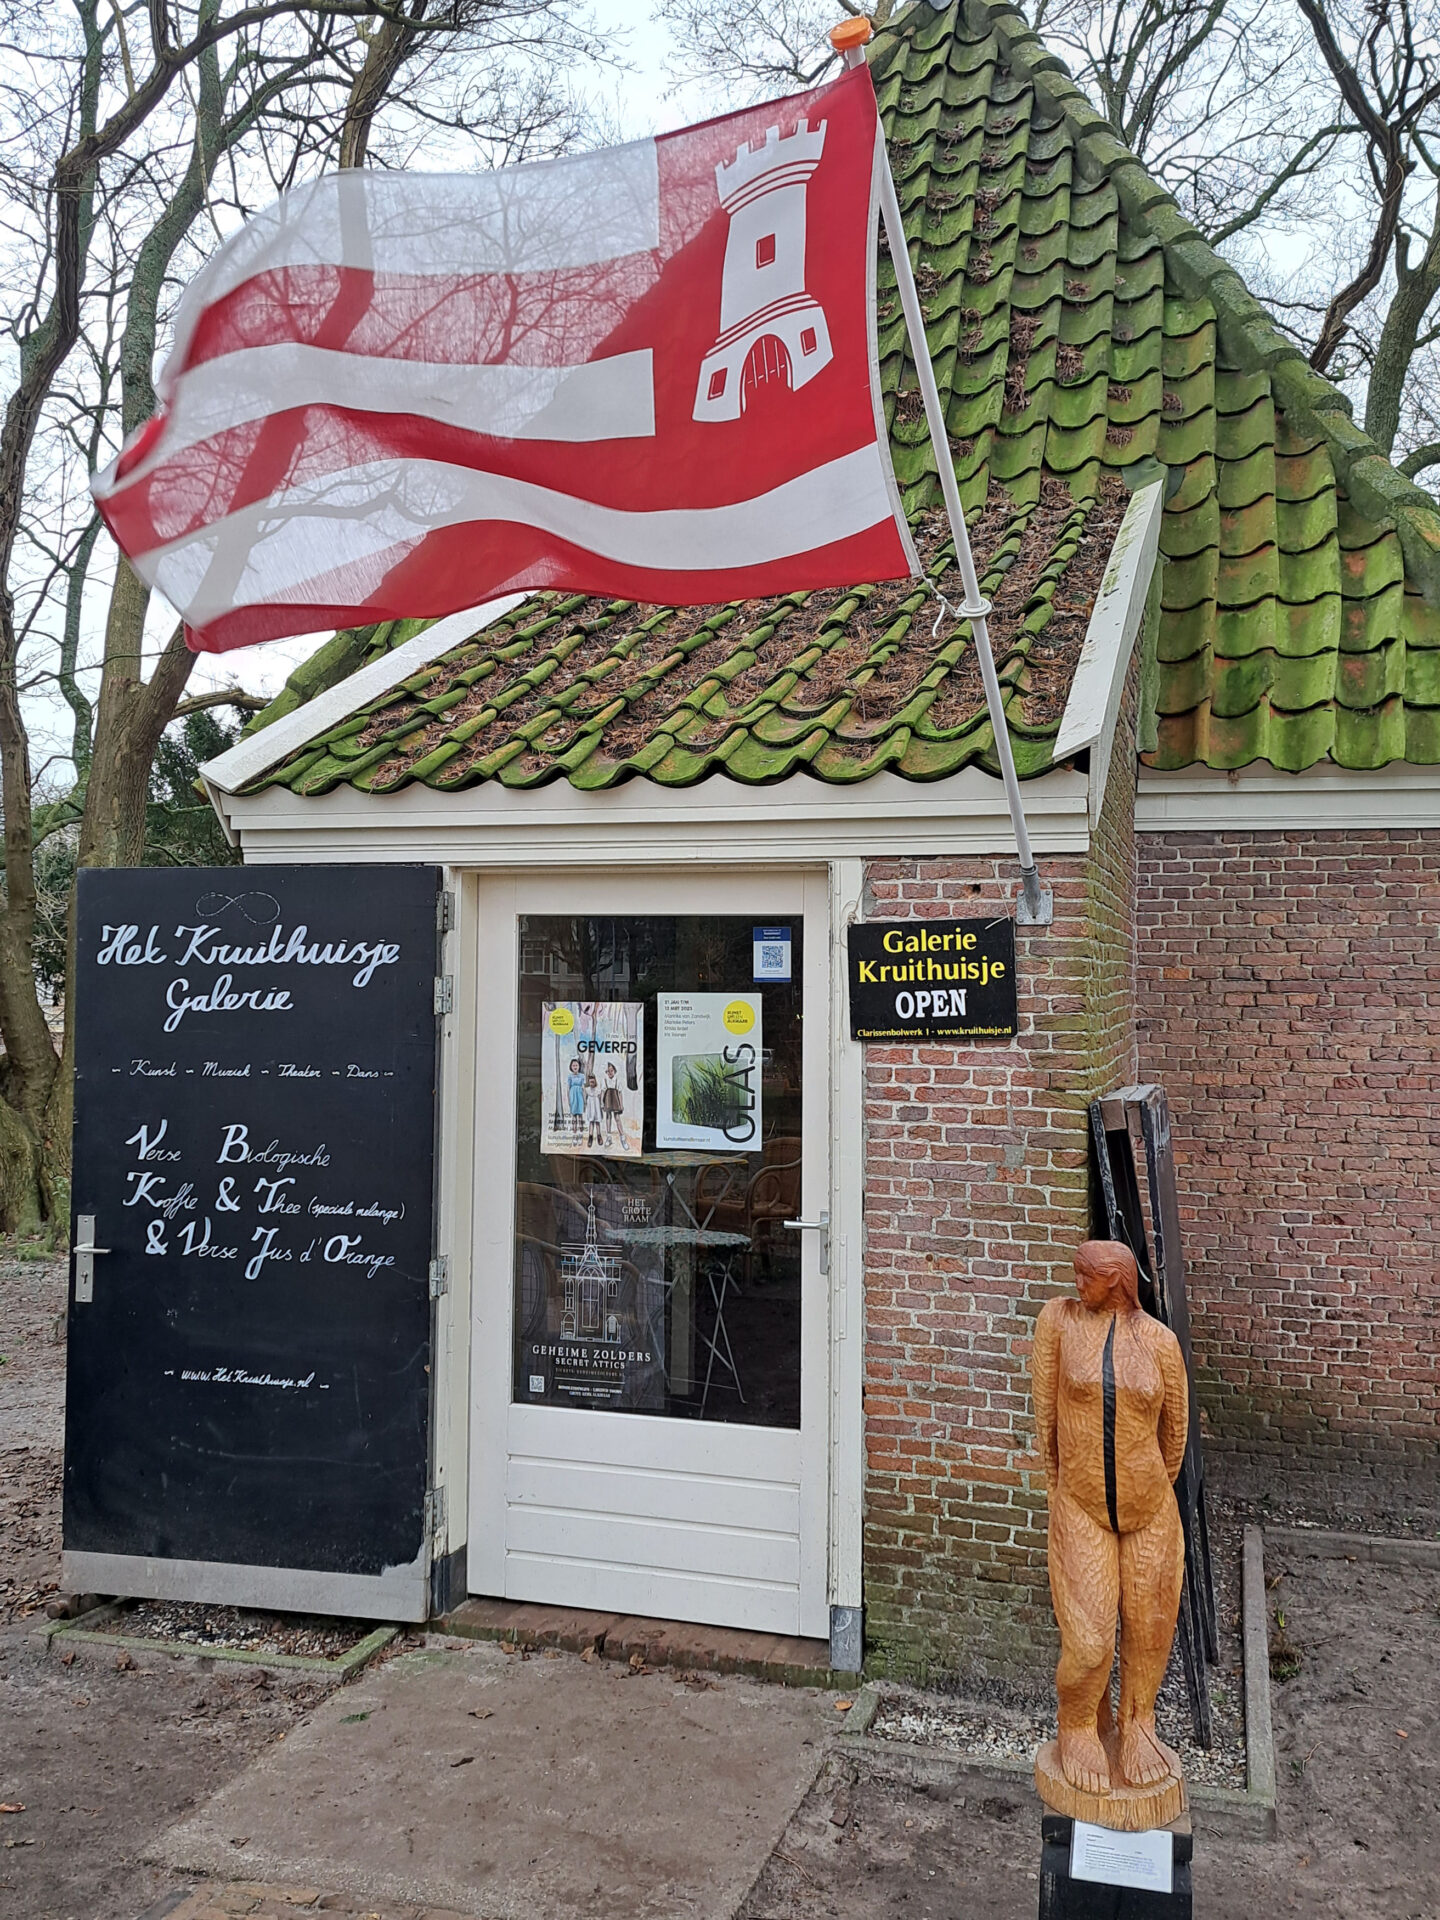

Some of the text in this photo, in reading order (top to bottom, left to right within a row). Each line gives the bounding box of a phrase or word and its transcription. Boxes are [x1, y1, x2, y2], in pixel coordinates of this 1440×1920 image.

[883, 927, 977, 953] Galerie
[97, 924, 401, 988] Het Kruithuisje
[858, 955, 1006, 986] Kruithuisje
[163, 973, 294, 1033] Galerie
[895, 988, 967, 1020] OPEN
[857, 1027, 923, 1037] Clarissenbolwerk
[937, 1026, 1012, 1037] www.kruithuisje.nl
[577, 1040, 637, 1054] GEVERFD
[130, 1059, 177, 1077] Kunst
[201, 1061, 251, 1078] Muziek
[278, 1063, 321, 1079] Theater
[346, 1065, 380, 1079] Dans
[722, 1043, 756, 1144] GLAS
[125, 1119, 331, 1173] Verse Biologische
[122, 1171, 199, 1220] Koffie
[215, 1176, 241, 1212] &
[253, 1177, 301, 1214] Thee
[627, 1198, 646, 1207] HET
[621, 1206, 652, 1215] GROTE
[623, 1215, 649, 1223] RAAM
[145, 1219, 168, 1255] &
[176, 1216, 238, 1259] Verse
[244, 1227, 293, 1280] Jus
[532, 1345, 651, 1362] GEHEIME ZOLDERS
[555, 1357, 626, 1370] SECRET ATTICS
